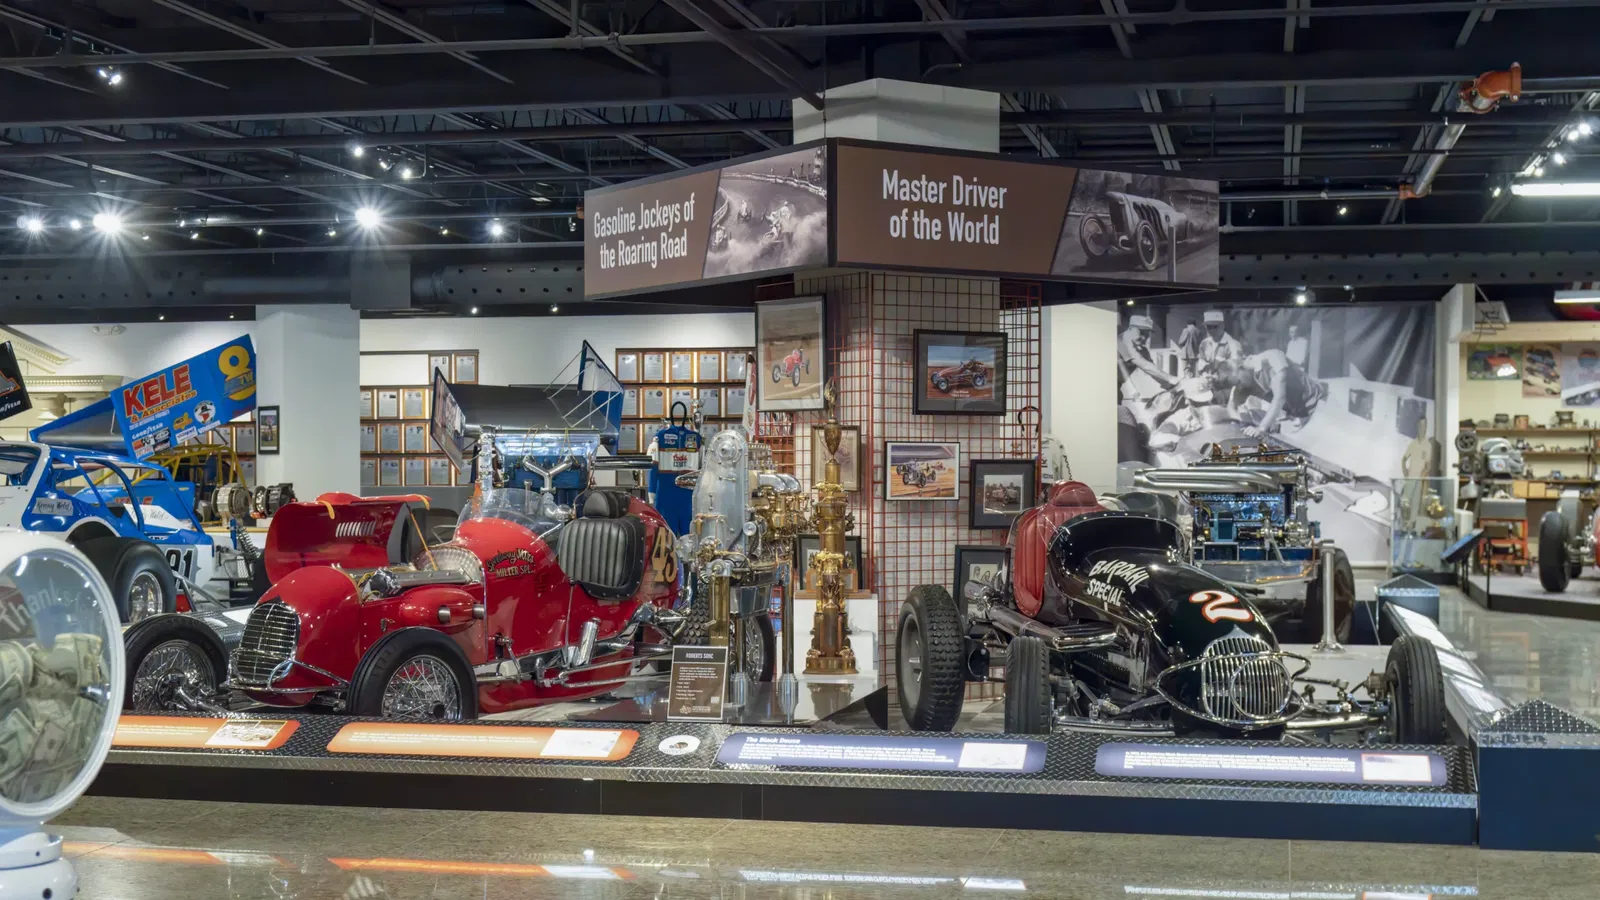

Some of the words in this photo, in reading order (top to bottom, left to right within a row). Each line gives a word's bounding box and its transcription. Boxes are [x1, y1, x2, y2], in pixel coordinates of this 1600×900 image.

[882, 168, 947, 204] Master
[952, 174, 1008, 209] Driver
[594, 207, 636, 238] Gasoline
[638, 199, 681, 232] Jockeys
[683, 192, 696, 222] of
[889, 207, 909, 239] of
[912, 208, 942, 241] the
[947, 211, 1000, 245] World
[600, 242, 616, 269] the
[618, 235, 657, 269] Roaring
[660, 228, 688, 260] Road
[123, 364, 192, 418] KELE
[496, 565, 519, 578] MILLER
[1088, 559, 1150, 595] BARDAHL
[1086, 579, 1126, 611] SPECIAL
[1188, 589, 1254, 624] 2
